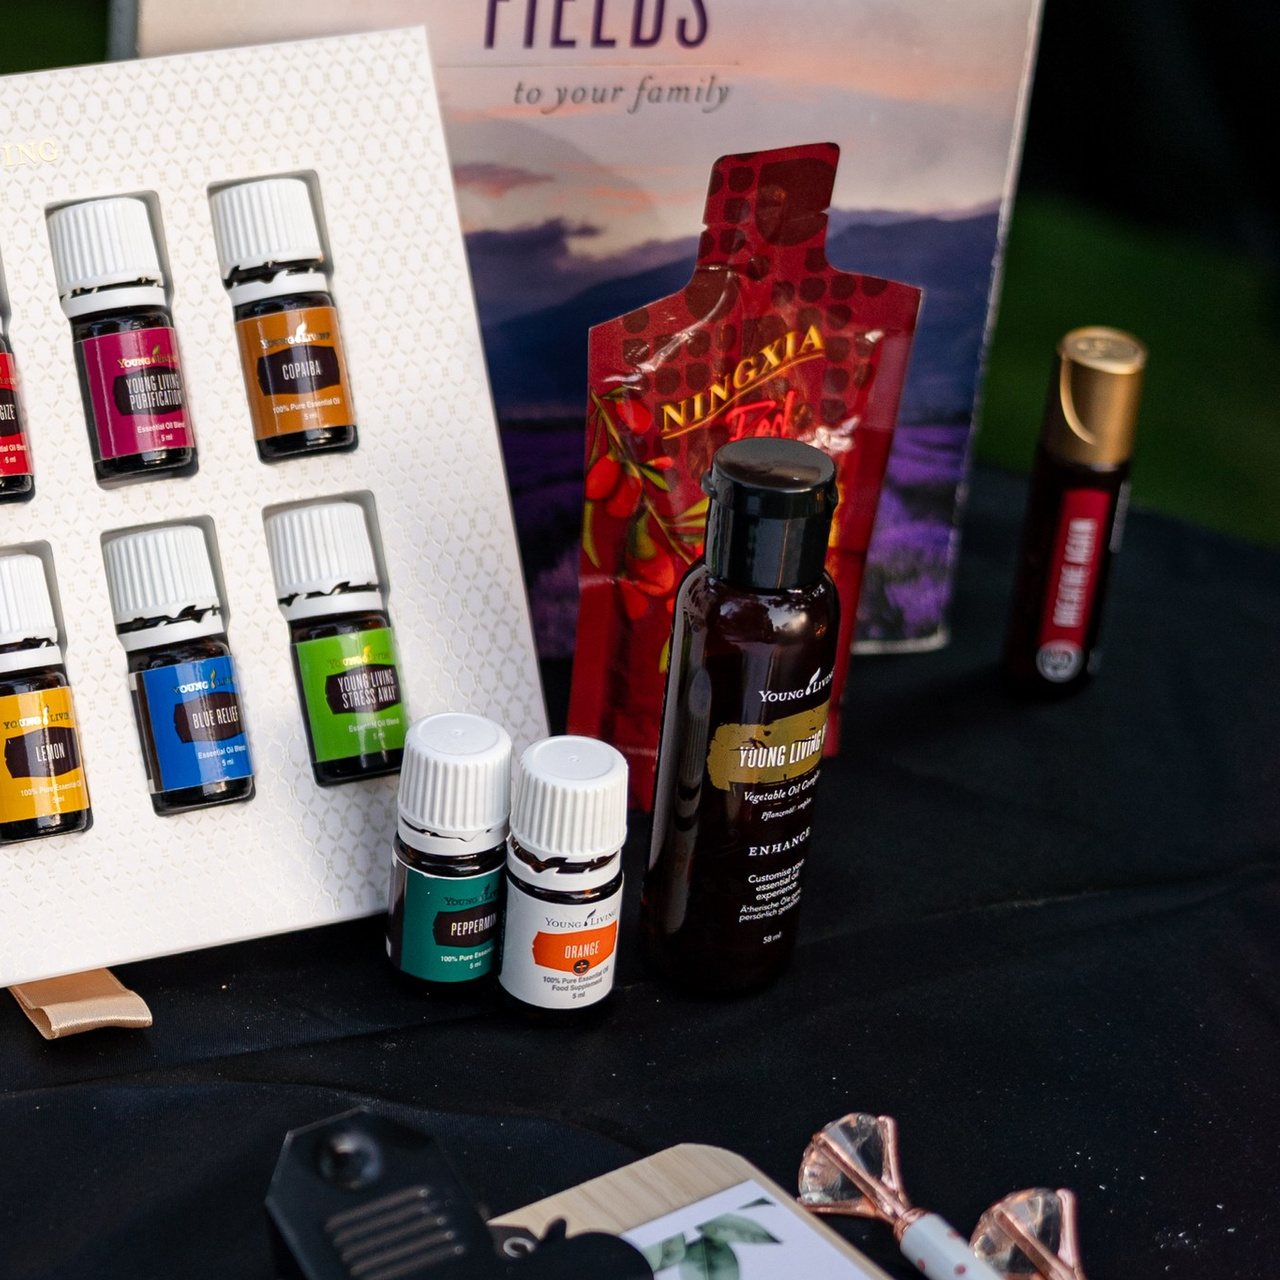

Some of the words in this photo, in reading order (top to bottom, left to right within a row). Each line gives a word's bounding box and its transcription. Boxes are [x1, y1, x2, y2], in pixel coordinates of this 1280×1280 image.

[513, 81, 542, 106] to
[545, 87, 625, 115] your
[627, 75, 732, 115] family
[117, 357, 151, 369] YOUNG
[282, 360, 321, 380] COPAIBA
[126, 376, 157, 394] YOUNG
[157, 373, 180, 391] LIVING
[661, 324, 825, 433] NINGXIA
[129, 389, 183, 411] PURIFICATION
[290, 402, 306, 411] Pure
[306, 398, 332, 408] Essential
[137, 423, 165, 433] Essential
[165, 422, 173, 430] Oil
[161, 434, 166, 442] 5
[5, 456, 10, 464] 5
[337, 673, 370, 694] YOUNG
[370, 669, 394, 688] LIVING
[342, 689, 376, 709] STRESS
[378, 685, 397, 703] AWAY
[758, 689, 804, 703] YOUNG
[192, 710, 216, 729] BLUE
[216, 705, 239, 725] RELIEF
[35, 742, 65, 762] LEMON
[198, 749, 225, 760] Essential
[226, 746, 234, 754] Oil
[739, 745, 787, 769] YOUNG
[789, 730, 822, 765] LIVING
[221, 759, 226, 767] 5
[227, 758, 234, 766] ml
[21, 787, 38, 797] 100%
[744, 788, 787, 804] Vegetable
[788, 782, 800, 797] Oil
[748, 826, 811, 857] ENHANCE
[748, 866, 792, 883] Customise
[756, 875, 791, 892] essential
[756, 881, 797, 901] experience
[545, 917, 581, 928] YOUNG
[739, 909, 777, 922] persönlich
[451, 913, 497, 936] PEPPERMIN
[763, 936, 772, 944] 58
[772, 931, 782, 940] ml
[459, 953, 473, 961] Pure
[564, 940, 600, 959] ORANGE
[474, 960, 482, 968] ml
[543, 975, 560, 984] 100%
[578, 972, 603, 984] Essential
[552, 984, 569, 992] Food
[570, 977, 603, 991] Supplement
[577, 991, 586, 999] ml
